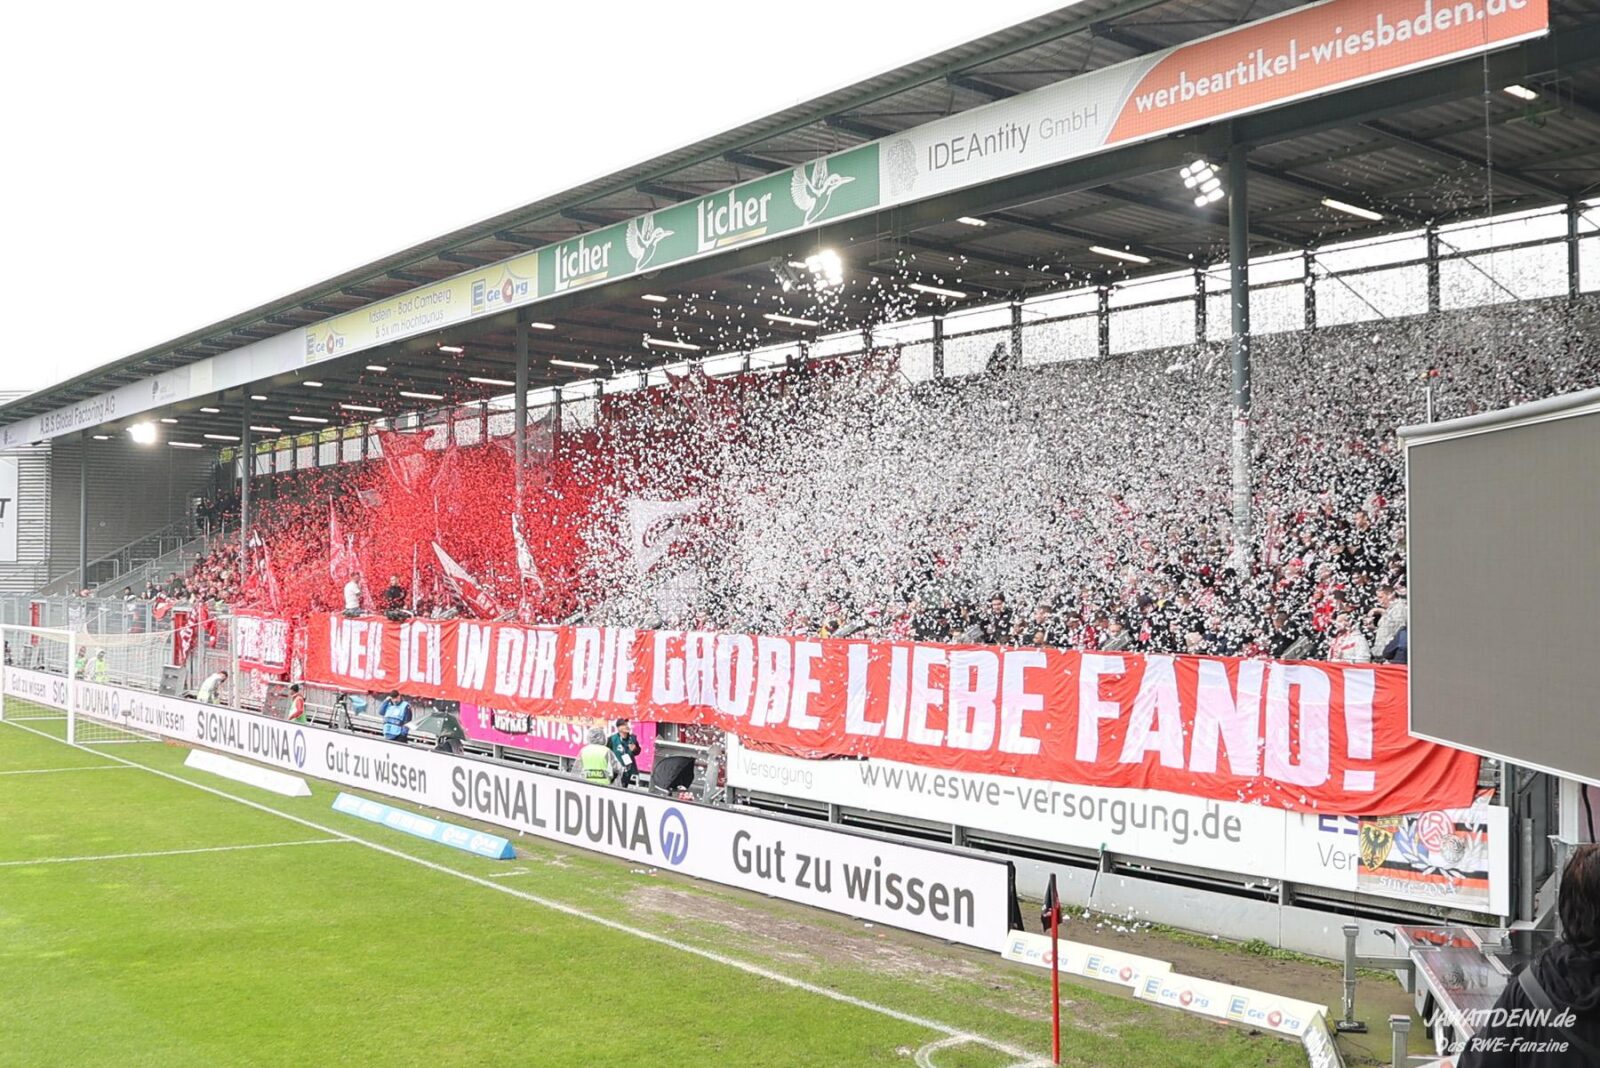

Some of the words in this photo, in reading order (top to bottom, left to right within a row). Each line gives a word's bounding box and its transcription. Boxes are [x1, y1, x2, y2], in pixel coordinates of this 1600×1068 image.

[1135, 0, 1527, 113] werbeartikel-wiesbaden.de
[928, 122, 1031, 172] IDEAntity
[1039, 103, 1098, 140] GmbH
[697, 189, 772, 254] Licher
[554, 237, 612, 292] Licher
[398, 300, 412, 315] Bad
[414, 288, 452, 310] Camberg
[401, 309, 444, 332] Hochtaunus
[56, 409, 73, 430] Global
[75, 400, 104, 424] Factoring
[104, 395, 115, 416] AG
[12, 673, 21, 691] Gut
[21, 679, 28, 693] zu
[29, 677, 46, 697] wissen
[53, 680, 80, 708] SIGL
[82, 686, 110, 717] IDUNA
[330, 616, 386, 681] WEIL
[399, 622, 442, 686] ICH
[456, 622, 491, 690] IN
[494, 626, 558, 700] DIR
[570, 627, 638, 704] DIE
[845, 643, 1047, 755] LIEBE
[1075, 652, 1376, 792] FAND!
[130, 699, 144, 722] Gut
[144, 705, 154, 725] zu
[156, 705, 185, 732] wissen
[197, 711, 244, 750] SIGNAL
[248, 722, 291, 763] IDUNA
[326, 742, 350, 775] Gut
[353, 754, 369, 779] zu
[374, 753, 427, 793] wissen
[743, 756, 814, 789] Versorgung
[452, 765, 546, 829] SIGNAL
[555, 788, 653, 856] IDUNA
[860, 764, 1242, 845] www.eswe-versorgung.de
[732, 829, 786, 883] Gut
[795, 853, 831, 894] zu
[843, 856, 975, 928] wissen
